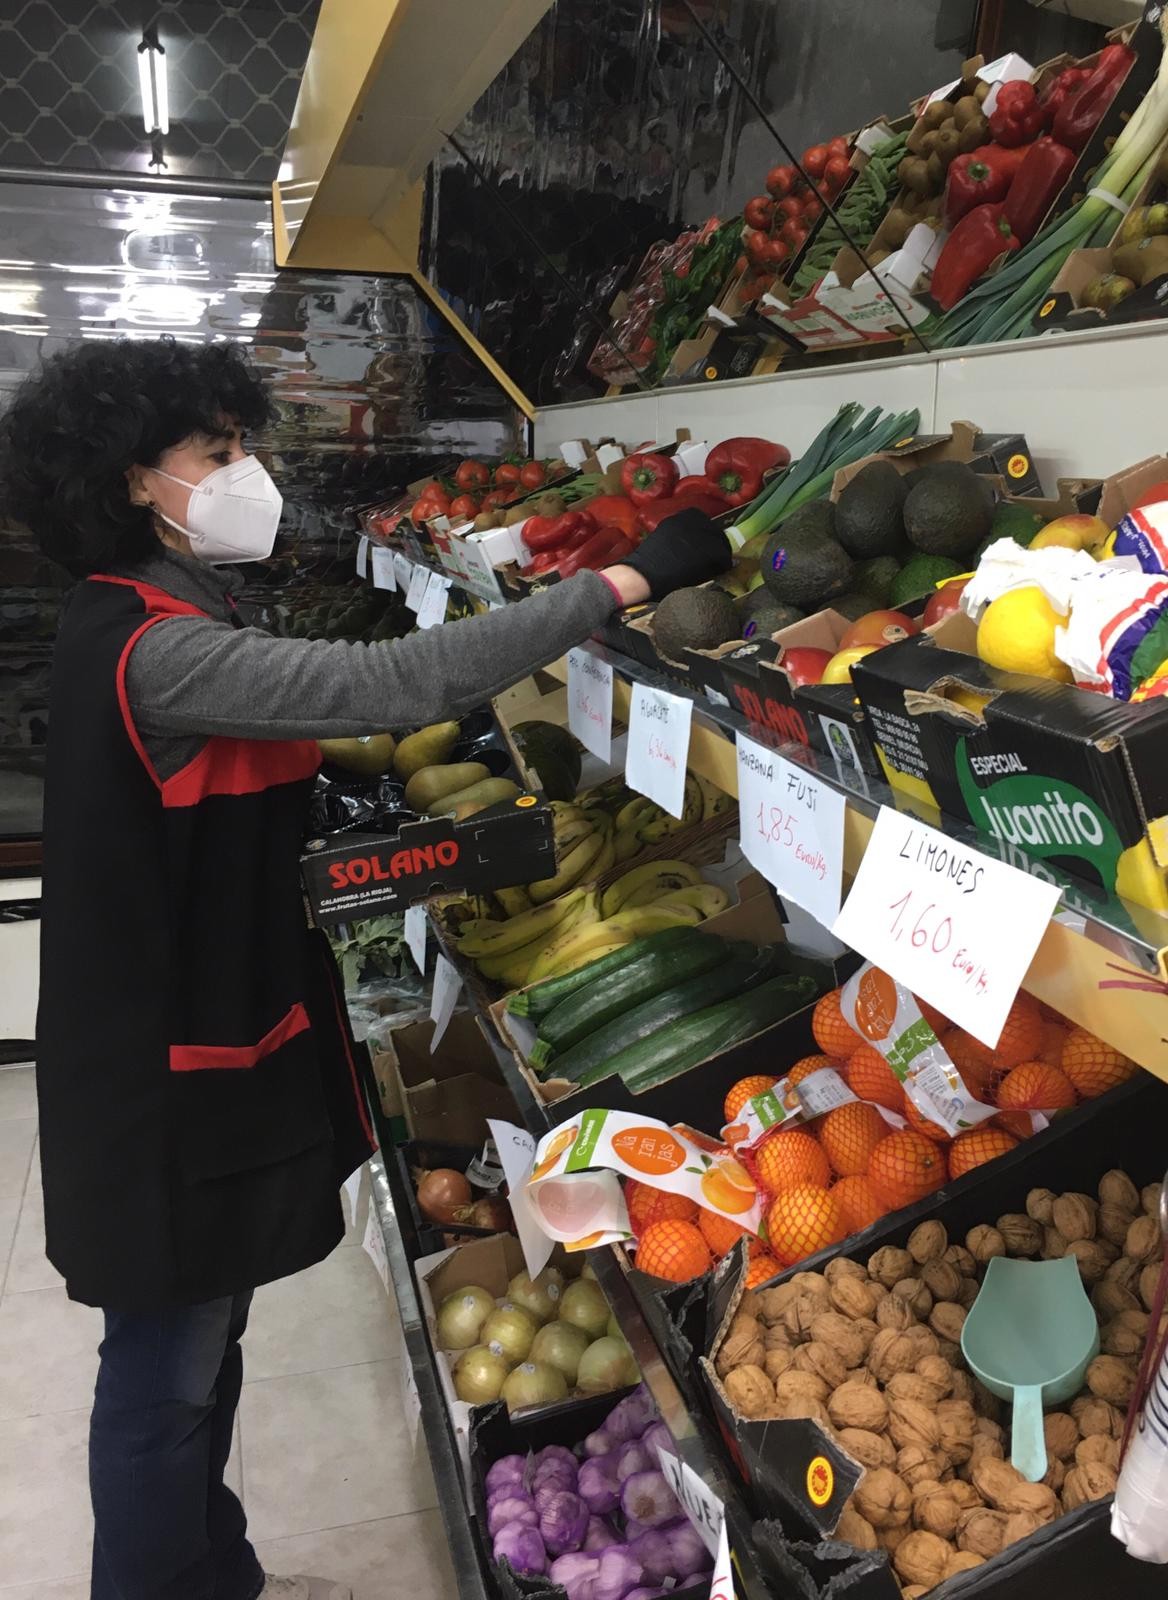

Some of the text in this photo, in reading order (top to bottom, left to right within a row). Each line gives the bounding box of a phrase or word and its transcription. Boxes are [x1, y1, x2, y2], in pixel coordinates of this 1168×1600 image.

[734, 684, 809, 745] SOLANO
[971, 753, 1028, 775] ESPECIAL
[757, 802, 798, 846] 1,85
[980, 791, 1104, 846] Juanito
[328, 841, 460, 889] SOLANO
[899, 830, 985, 894] LIMONES
[890, 890, 952, 953] 1,60
